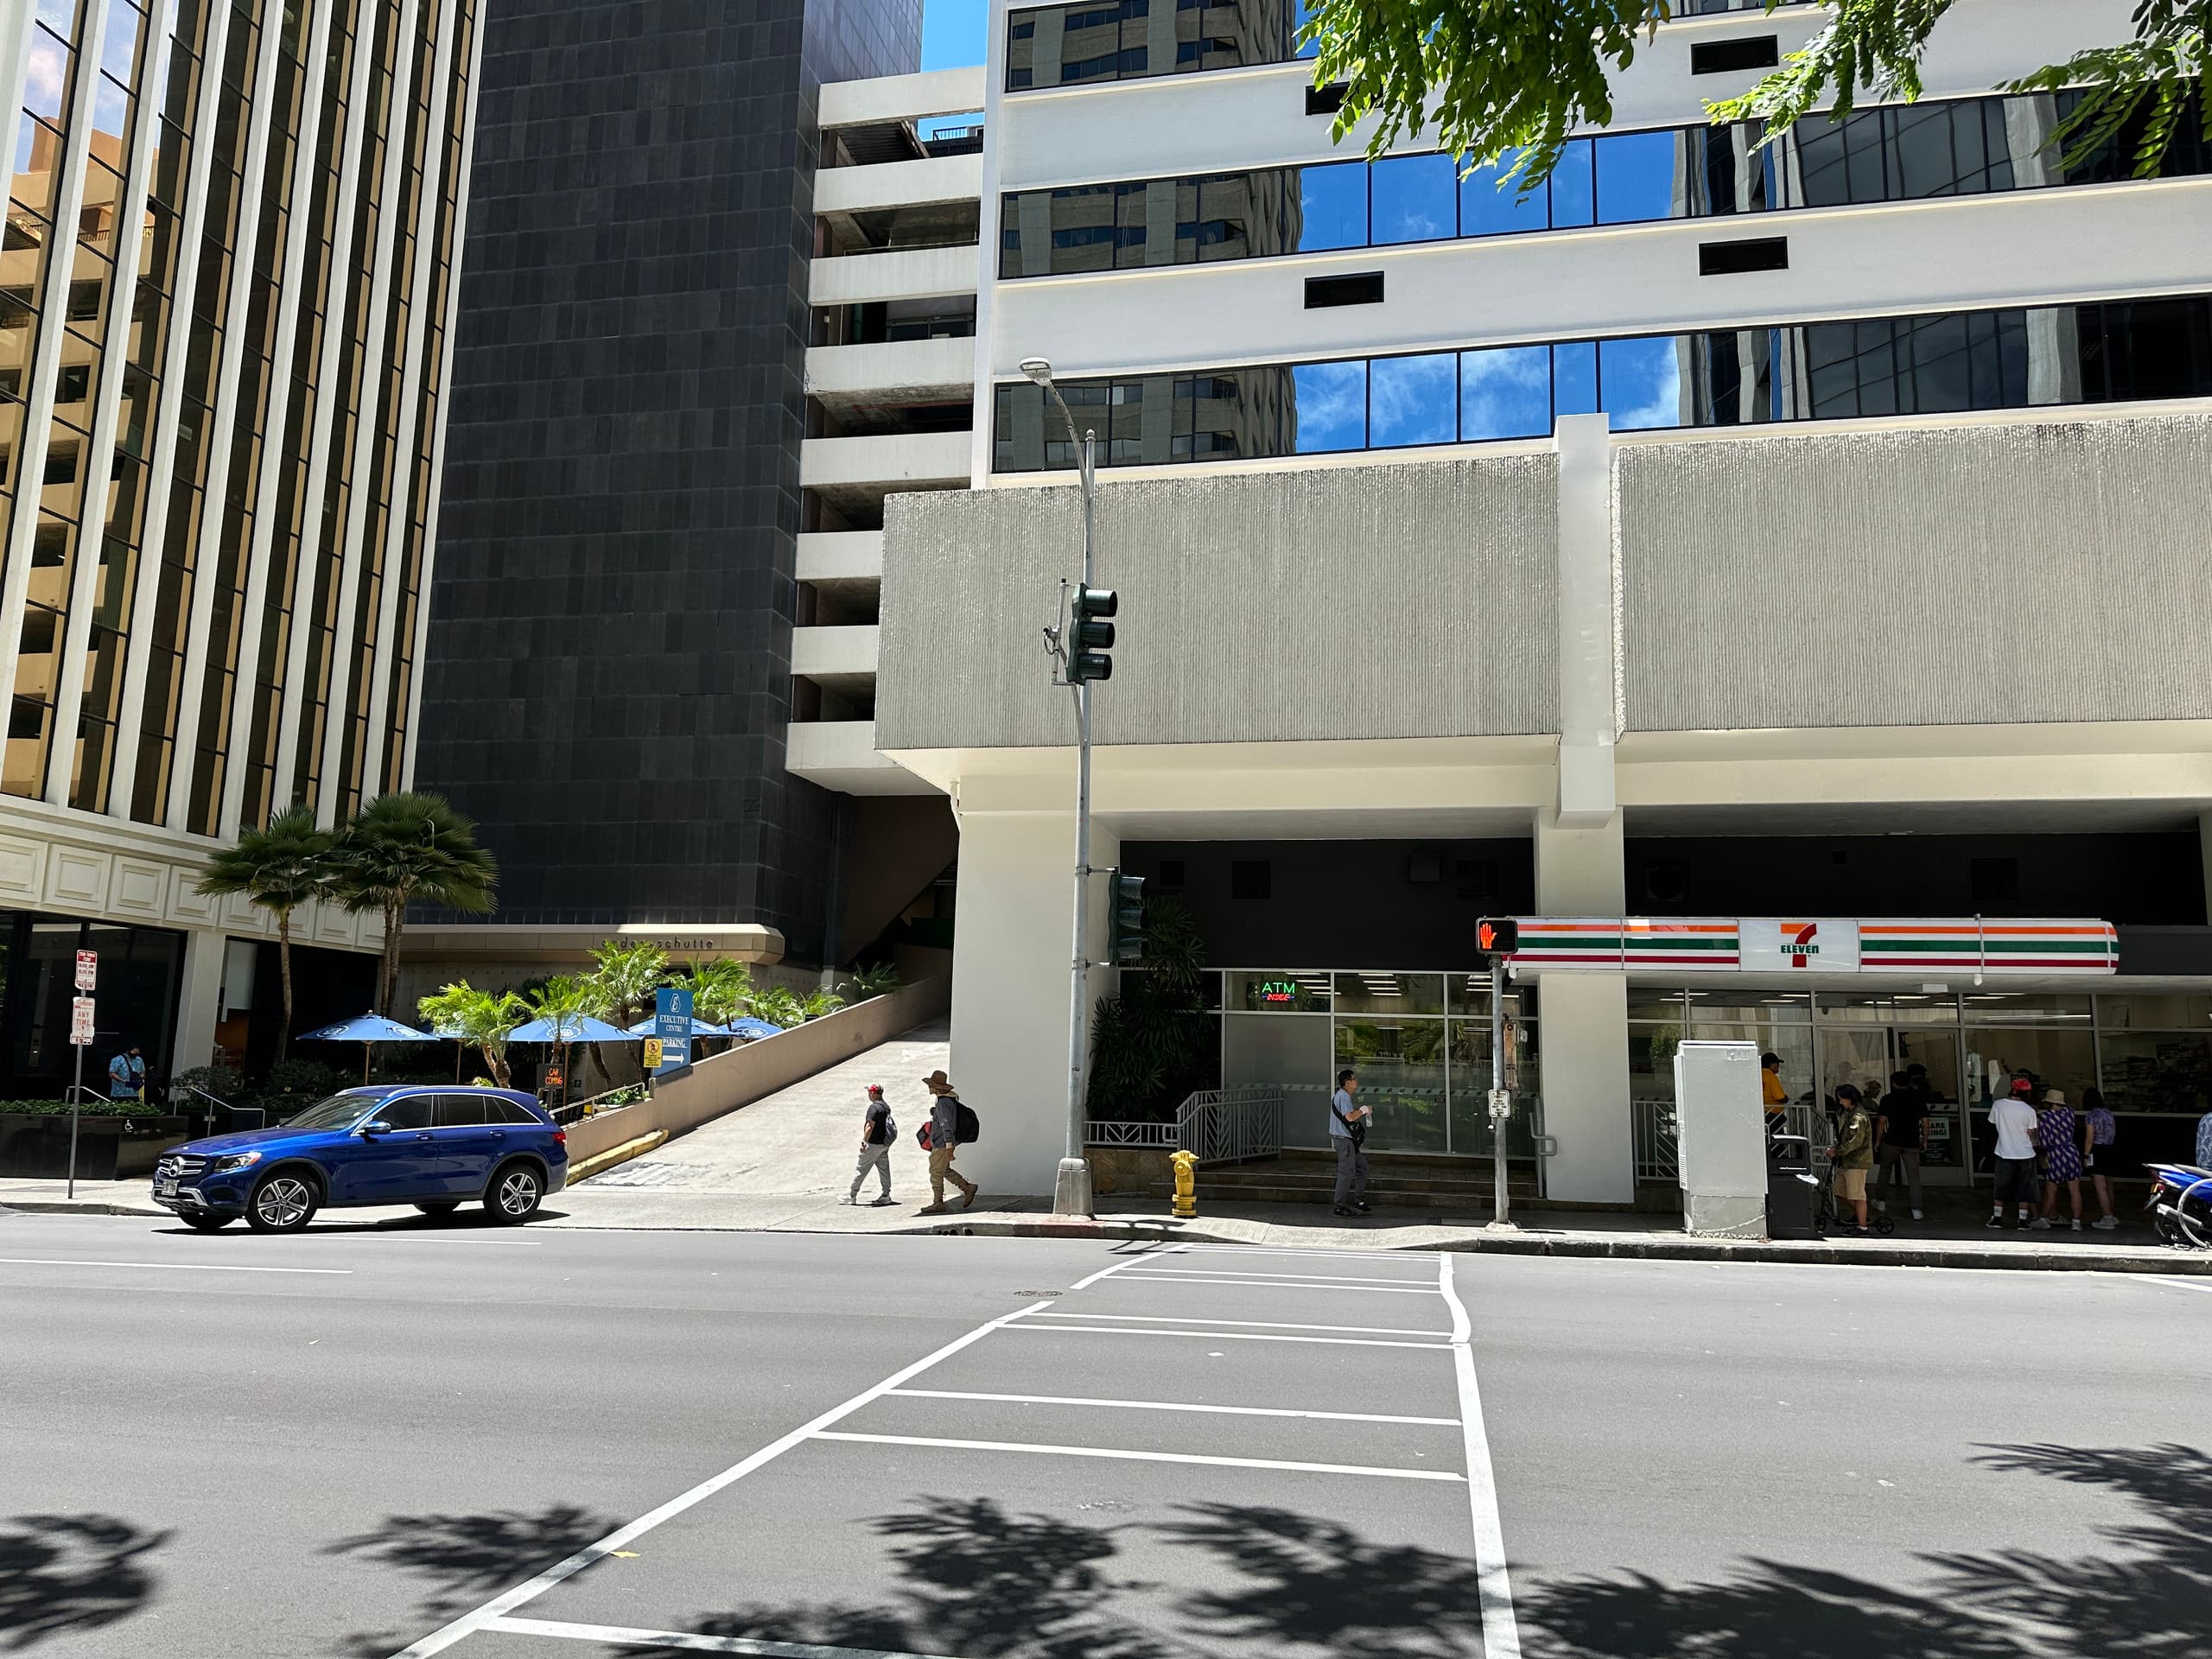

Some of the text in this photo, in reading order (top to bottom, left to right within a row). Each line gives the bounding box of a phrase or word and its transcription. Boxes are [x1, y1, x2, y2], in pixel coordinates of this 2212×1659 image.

[658, 937, 713, 949] schutte
[1262, 982, 1295, 994] ATM
[659, 1014, 689, 1025] EXECUTIVE
[663, 1037, 686, 1047] PARKING
